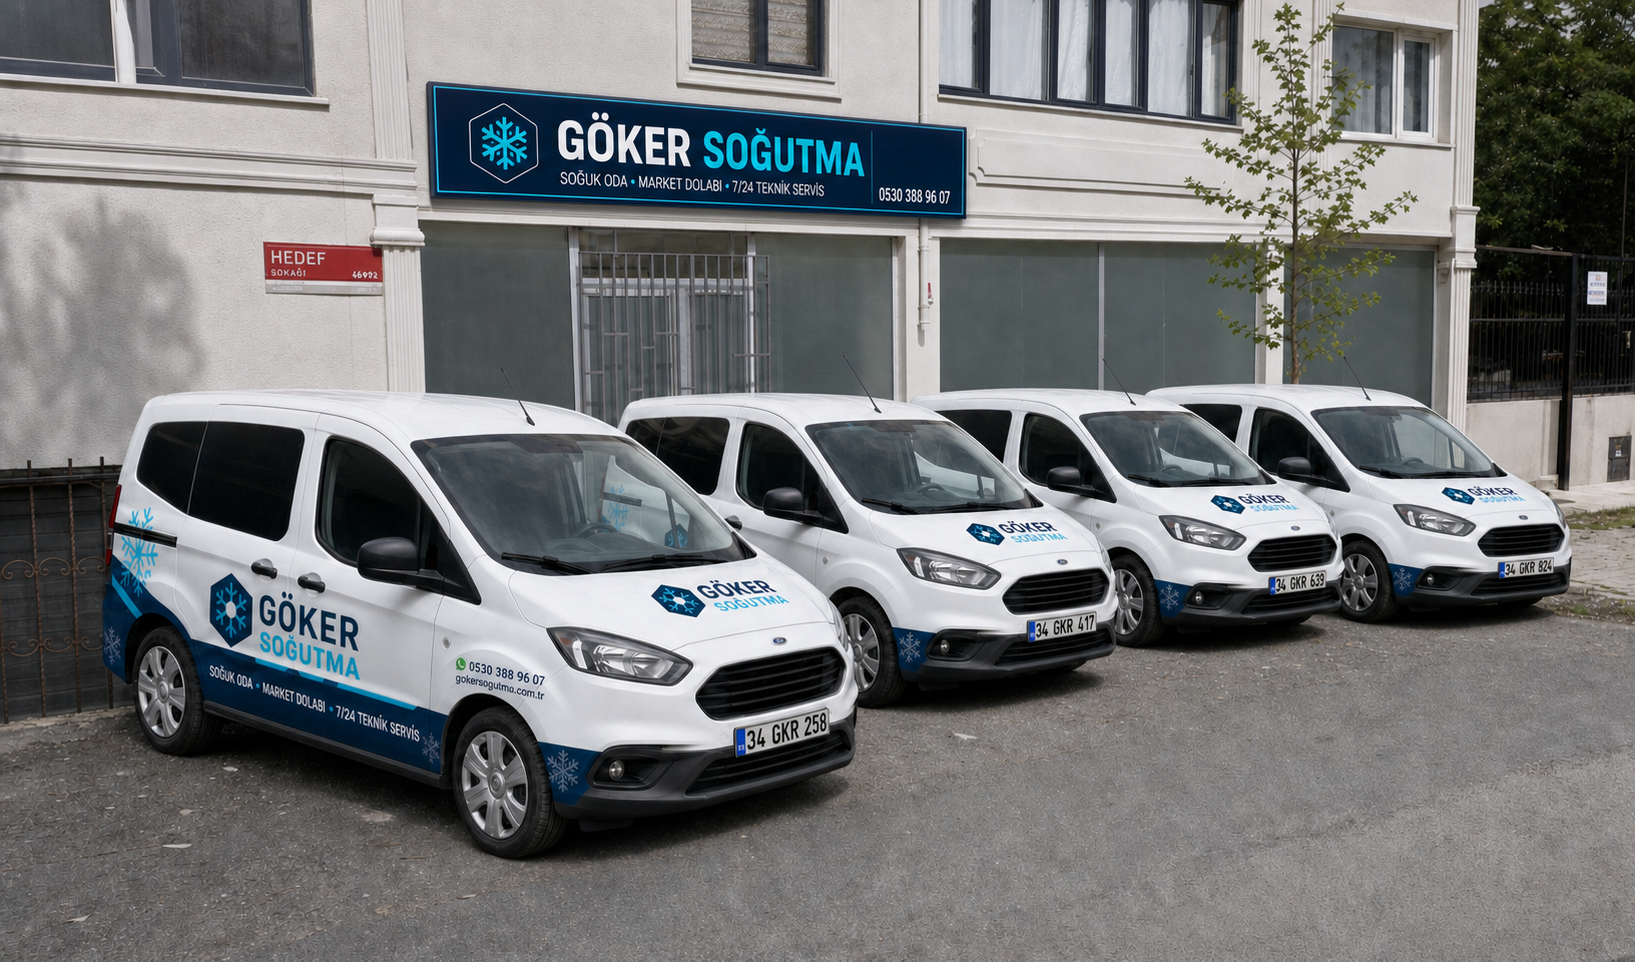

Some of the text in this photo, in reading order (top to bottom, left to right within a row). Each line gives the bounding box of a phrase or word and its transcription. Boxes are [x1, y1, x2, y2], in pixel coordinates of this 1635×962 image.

[557, 112, 865, 177] GÖKER SOĞUTMA
[560, 170, 825, 197] SOĞUK ODA MARKET DOLABI 7/24 TEKNİK SERVİS
[879, 187, 951, 204] 0530 388 96 07
[271, 250, 326, 265] HEDEF
[1238, 493, 1290, 504] GÖKER
[1467, 486, 1518, 496] GÖKER
[998, 521, 1058, 534] GÖKER
[1504, 559, 1552, 576] 34 GKR 824
[696, 579, 777, 599] GÖKER
[1276, 573, 1325, 592] 34 GKR 639
[259, 591, 359, 651] GÖKER
[1035, 615, 1095, 638] 34 GKR 417
[259, 631, 360, 681] SOĞUTMA
[469, 661, 545, 686] 0530 388 96 07
[455, 675, 545, 700] gokersogutma.com.tr
[209, 665, 420, 742] SOĞUK ODA MARKET DOLABI 7/24 TEKNİK SERVİS
[747, 712, 827, 750] 34 GKR 258
